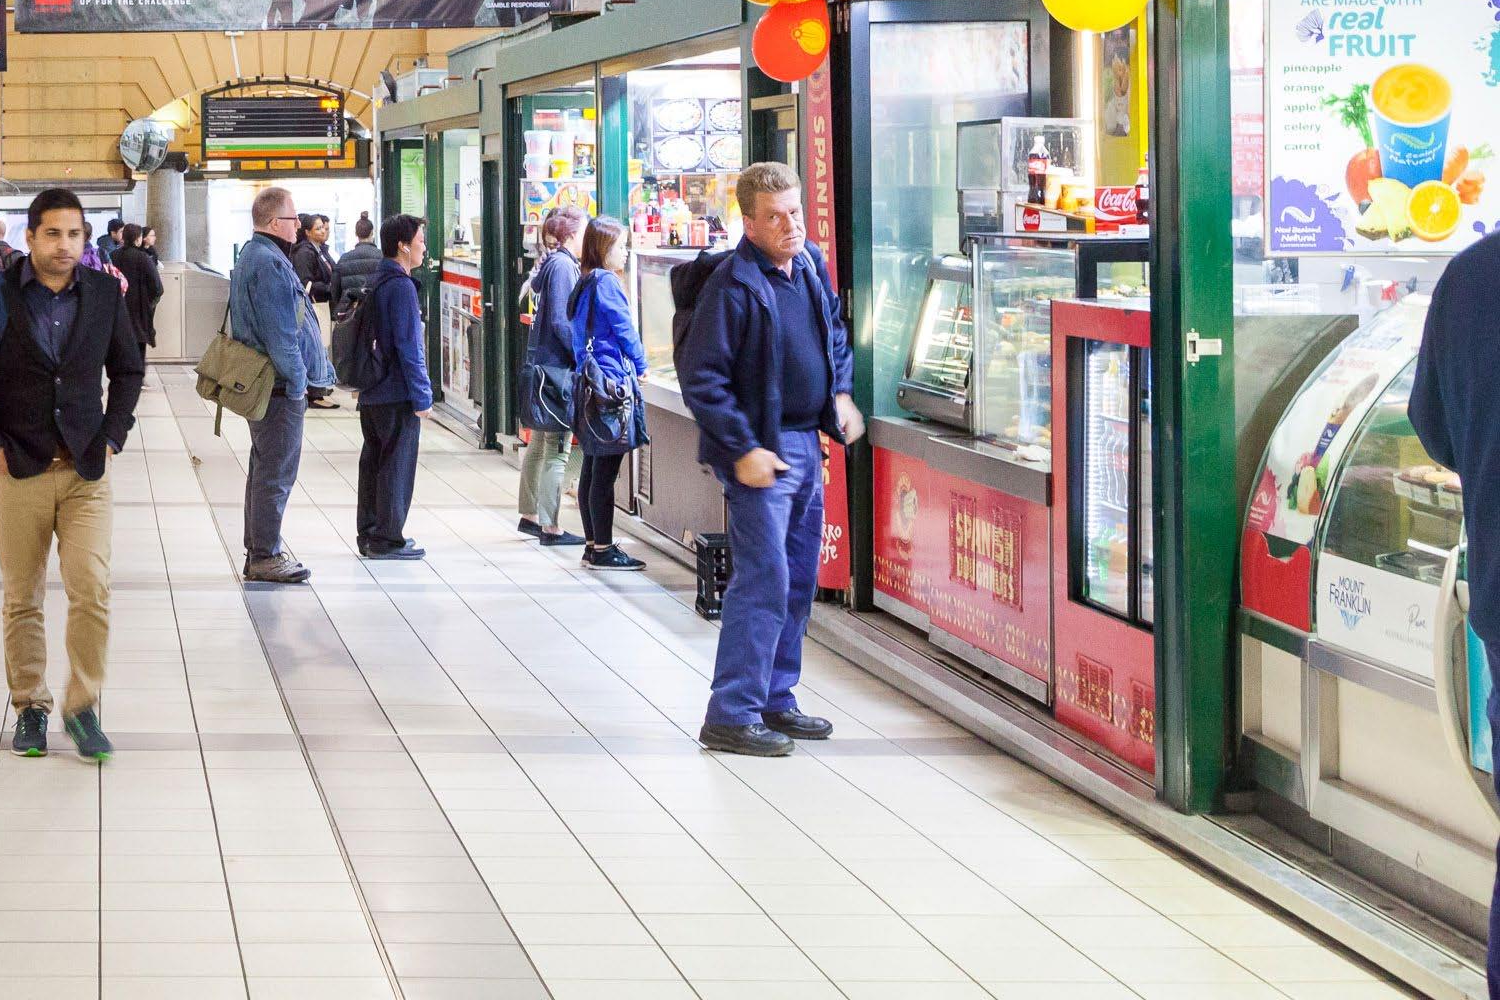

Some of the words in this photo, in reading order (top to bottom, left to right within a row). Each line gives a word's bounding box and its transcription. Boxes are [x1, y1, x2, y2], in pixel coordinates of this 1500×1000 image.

[1328, 6, 1384, 30] real
[1329, 34, 1417, 57] FRUIT
[1283, 63, 1342, 75] pineapple
[1283, 83, 1325, 94] orange
[1284, 102, 1317, 113] apple
[1284, 122, 1322, 133] celery
[1284, 142, 1322, 151] carrot
[813, 115, 830, 263] SPANISH
[1339, 576, 1365, 594] MOUNT
[1329, 583, 1372, 616] FRANKLIN
